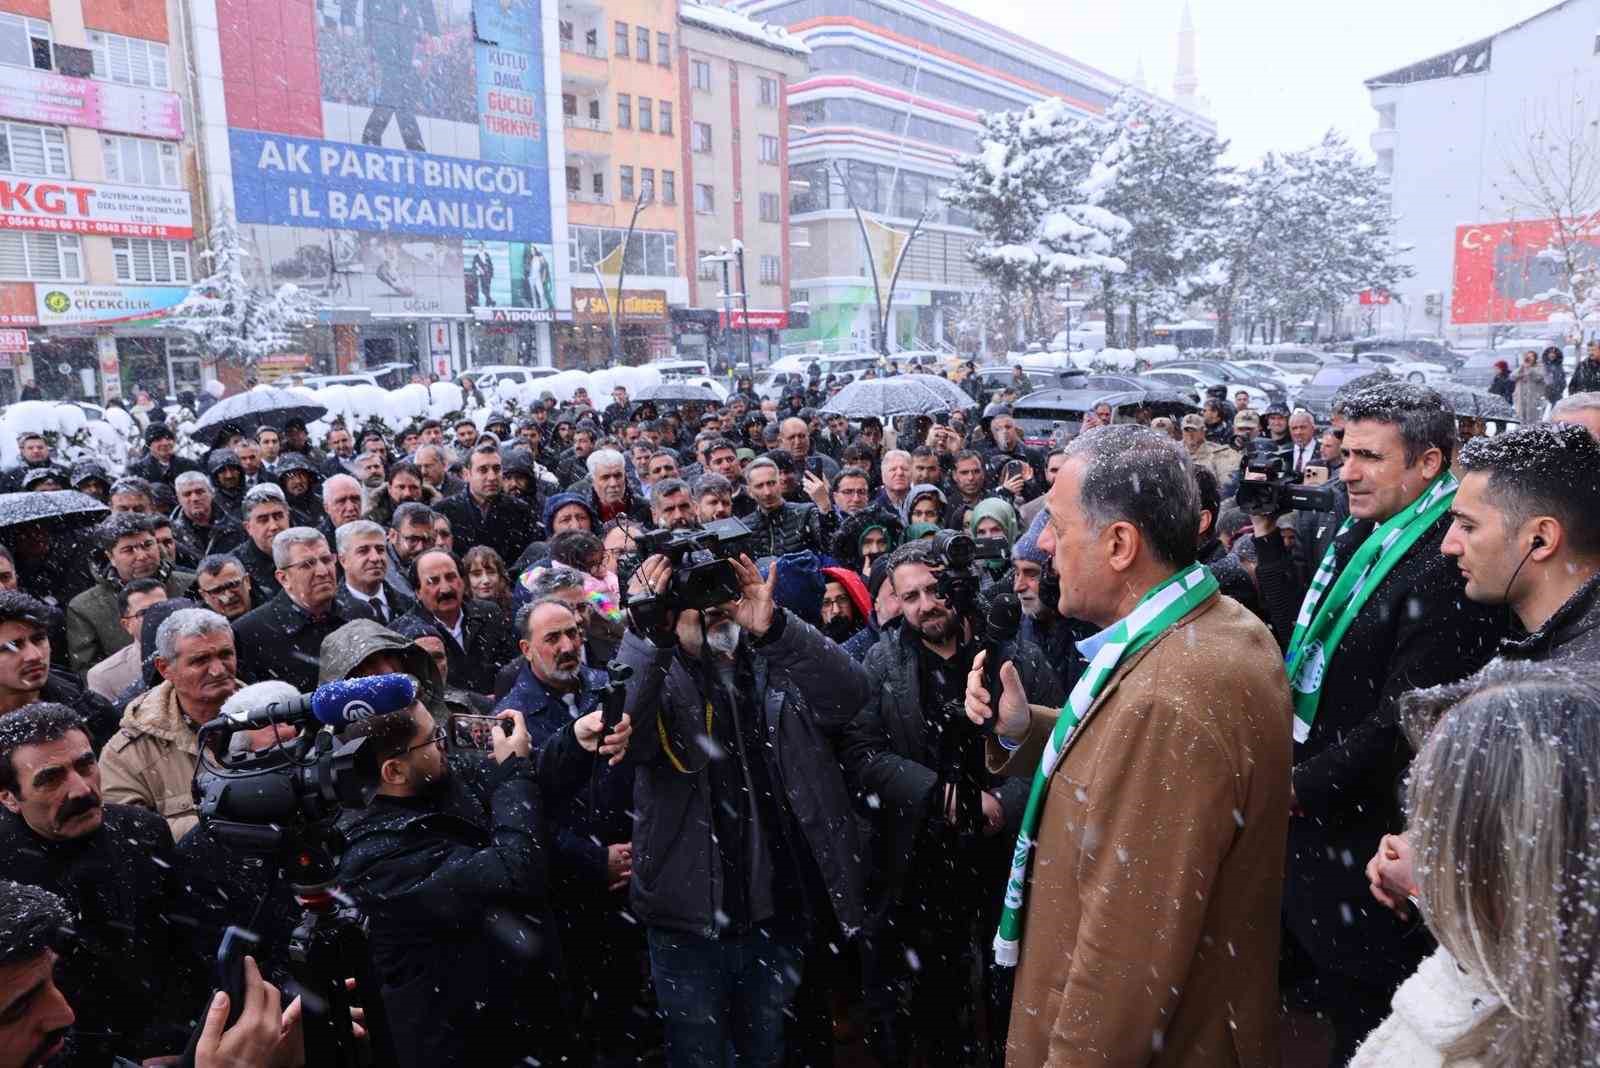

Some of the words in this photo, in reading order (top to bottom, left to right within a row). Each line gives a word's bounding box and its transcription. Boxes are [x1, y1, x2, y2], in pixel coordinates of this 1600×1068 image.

[488, 48, 527, 71] KUTLU
[494, 71, 522, 89] DAVA
[487, 90, 534, 117] GÜÇLÜ
[484, 114, 540, 138] TÜRKİYE
[257, 140, 312, 174] AK
[321, 147, 416, 185] PARTİ
[424, 159, 532, 197] BİNGÖL
[288, 187, 320, 218] İL
[328, 191, 514, 232] BAŞKANLIĞI
[74, 298, 151, 310] ÇİÇEKÇİLİK
